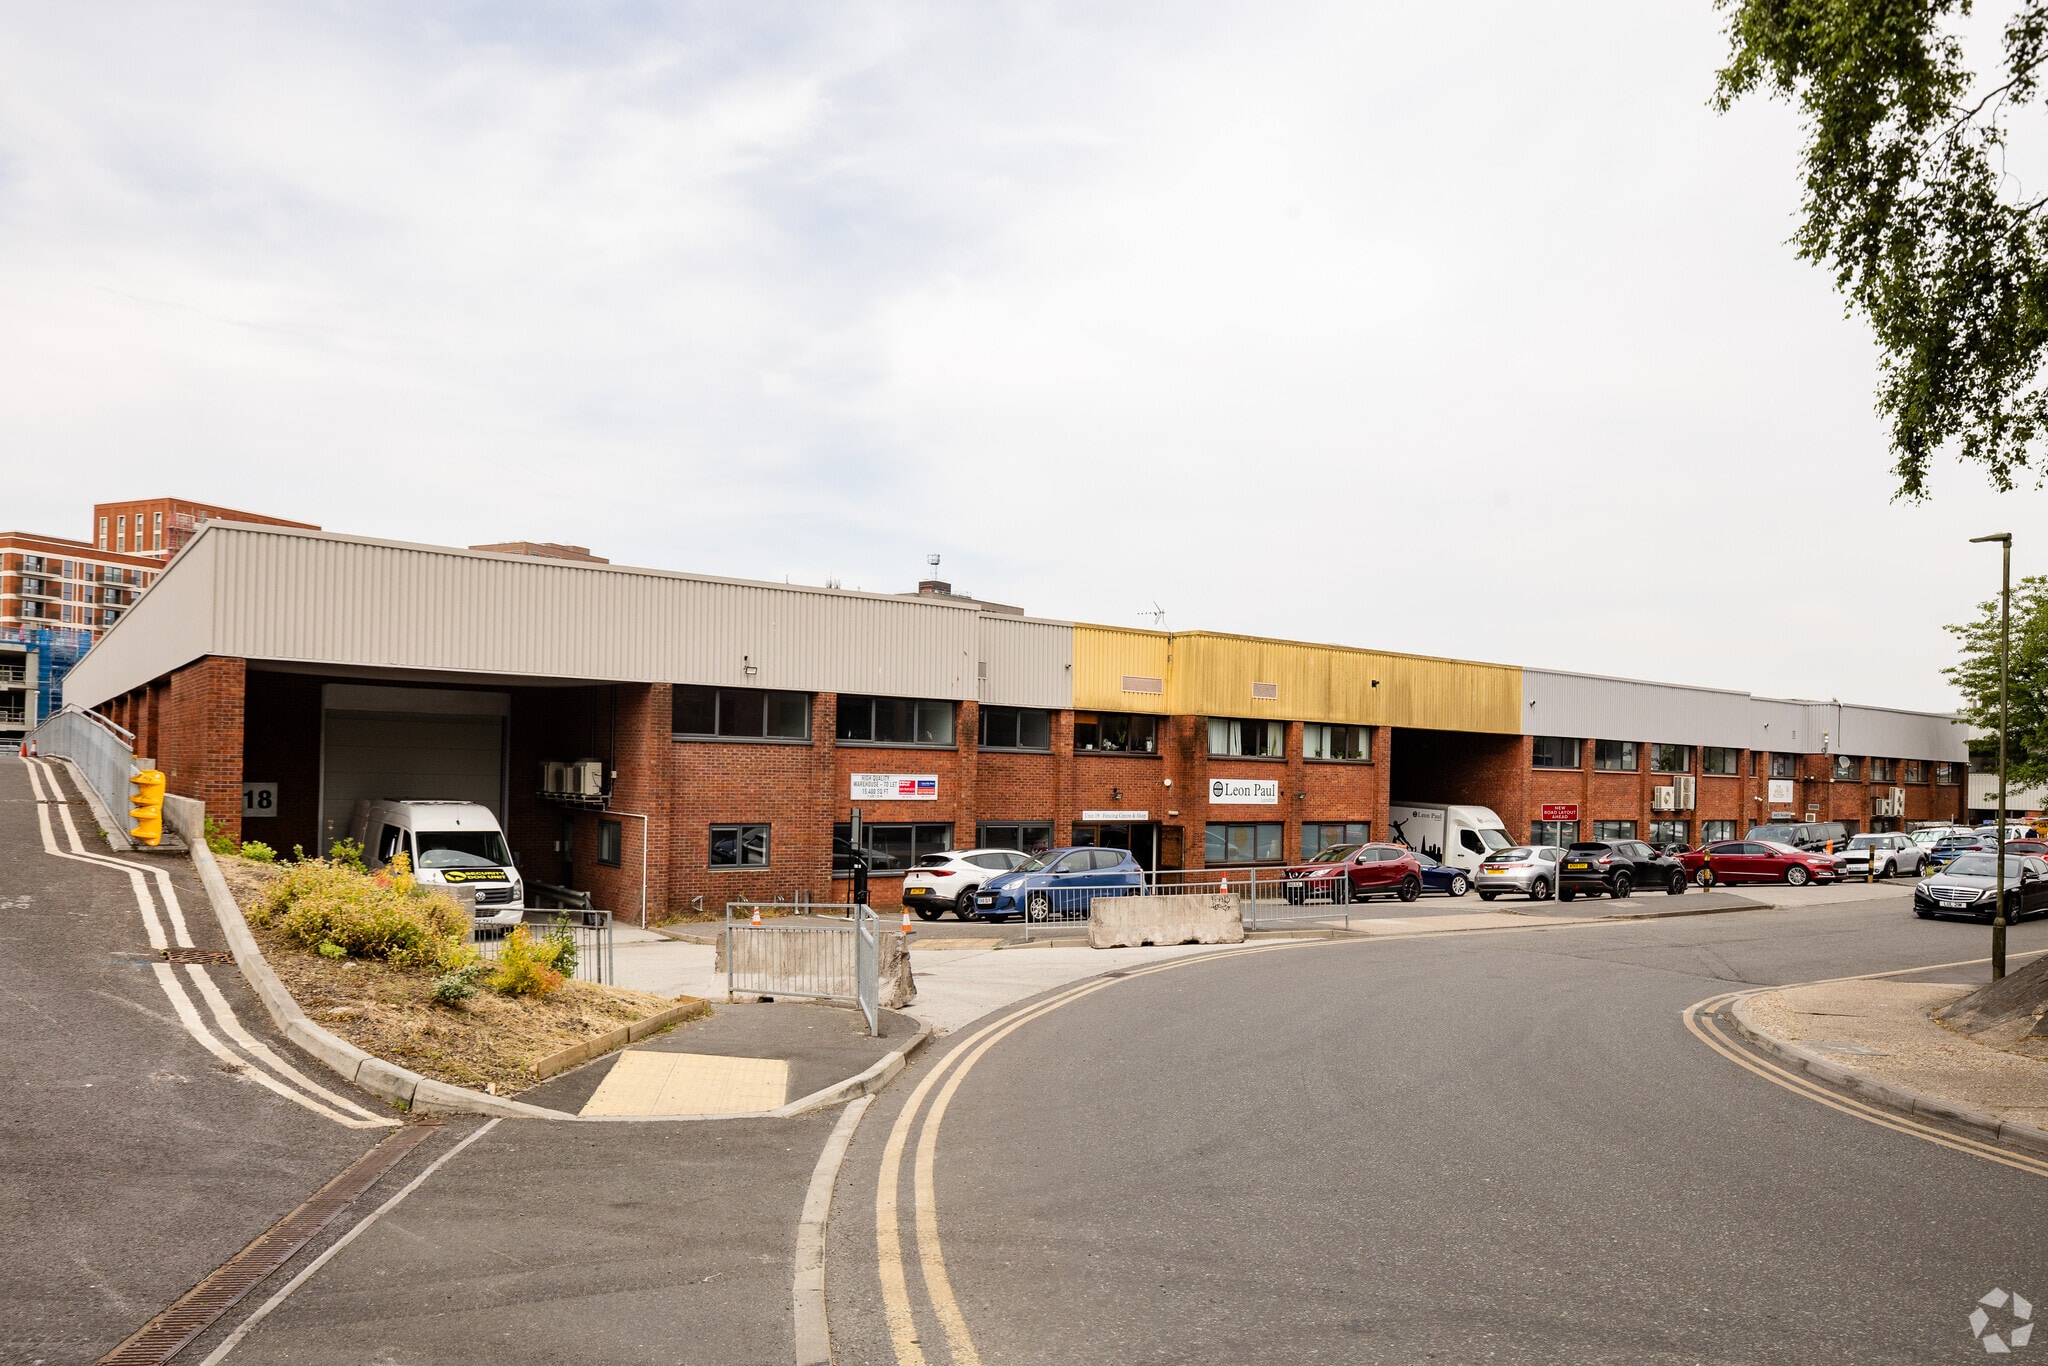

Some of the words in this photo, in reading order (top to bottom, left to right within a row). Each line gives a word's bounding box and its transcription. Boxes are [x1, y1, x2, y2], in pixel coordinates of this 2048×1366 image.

[1225, 783, 1251, 797] Leon
[1254, 783, 1276, 797] Paul
[243, 790, 273, 809] 18
